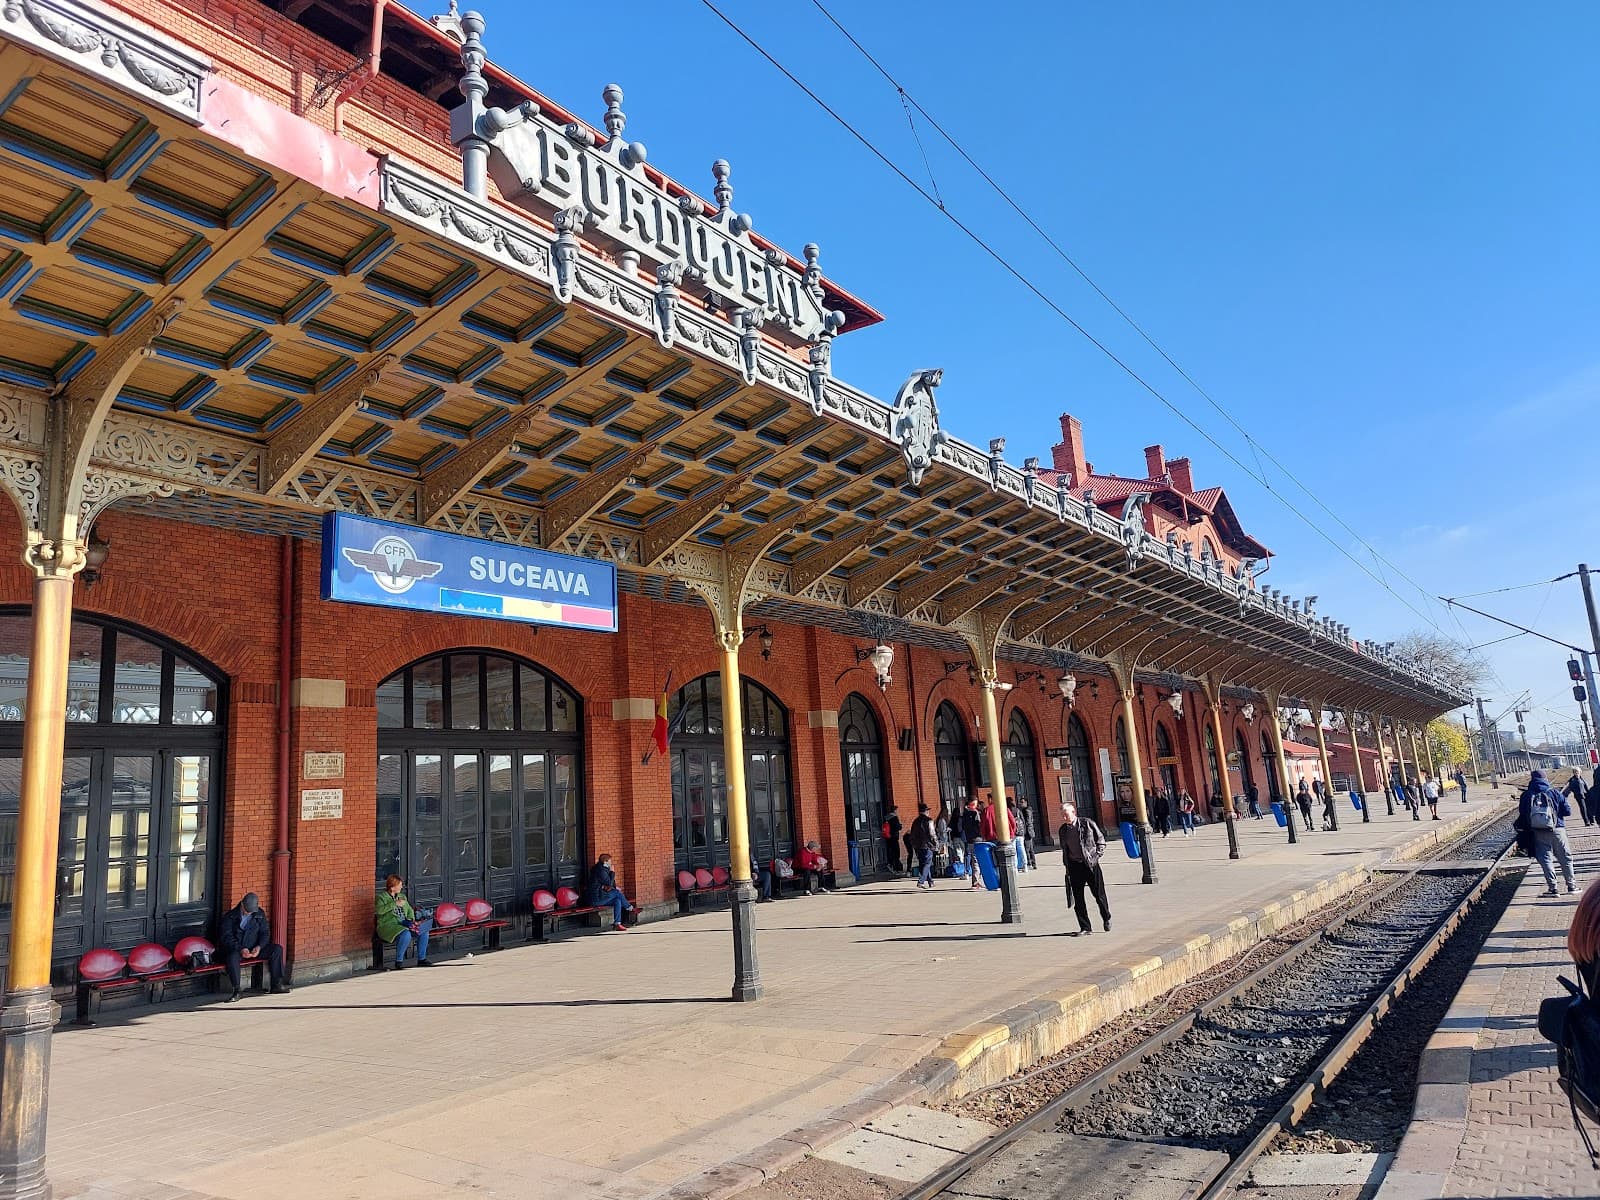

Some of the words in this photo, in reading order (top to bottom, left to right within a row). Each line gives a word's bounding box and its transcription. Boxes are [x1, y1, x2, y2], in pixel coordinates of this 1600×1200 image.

[536, 128, 807, 327] BURDUJENI
[384, 544, 407, 557] CFR
[469, 555, 590, 596] SUCEAVA
